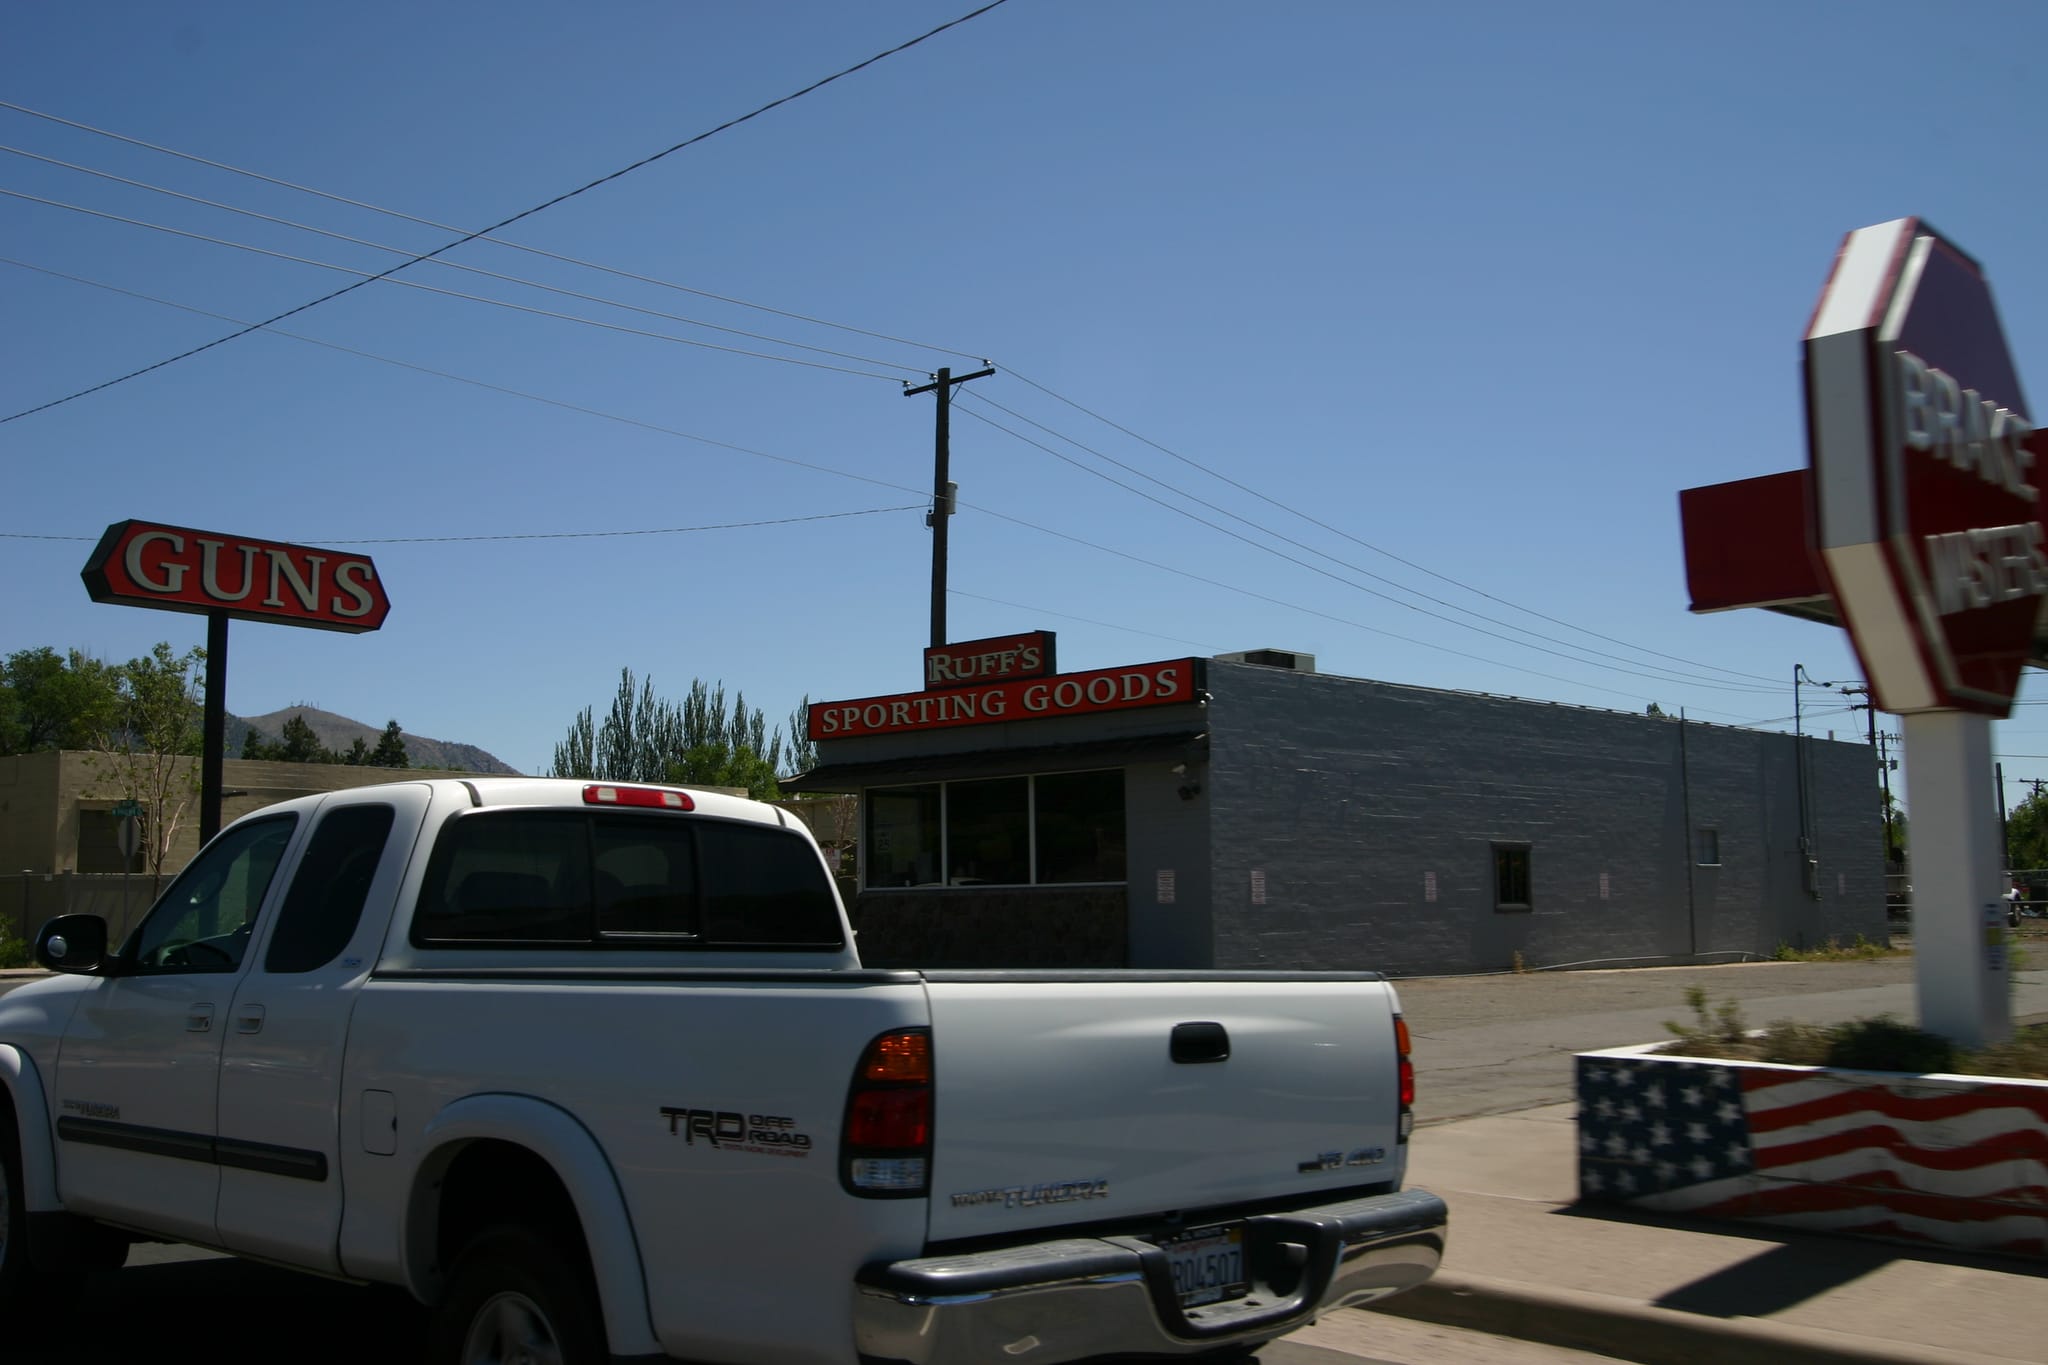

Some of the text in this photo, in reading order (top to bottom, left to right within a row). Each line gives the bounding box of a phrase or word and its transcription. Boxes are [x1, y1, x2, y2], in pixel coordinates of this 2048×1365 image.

[1896, 350, 2040, 502] BRAKE
[125, 531, 373, 617] GUNS
[928, 643, 1041, 682] RUFF'S
[821, 668, 1178, 734] SPORTING GOODS
[660, 1106, 745, 1149] TRD
[749, 1130, 812, 1149] ROAD
